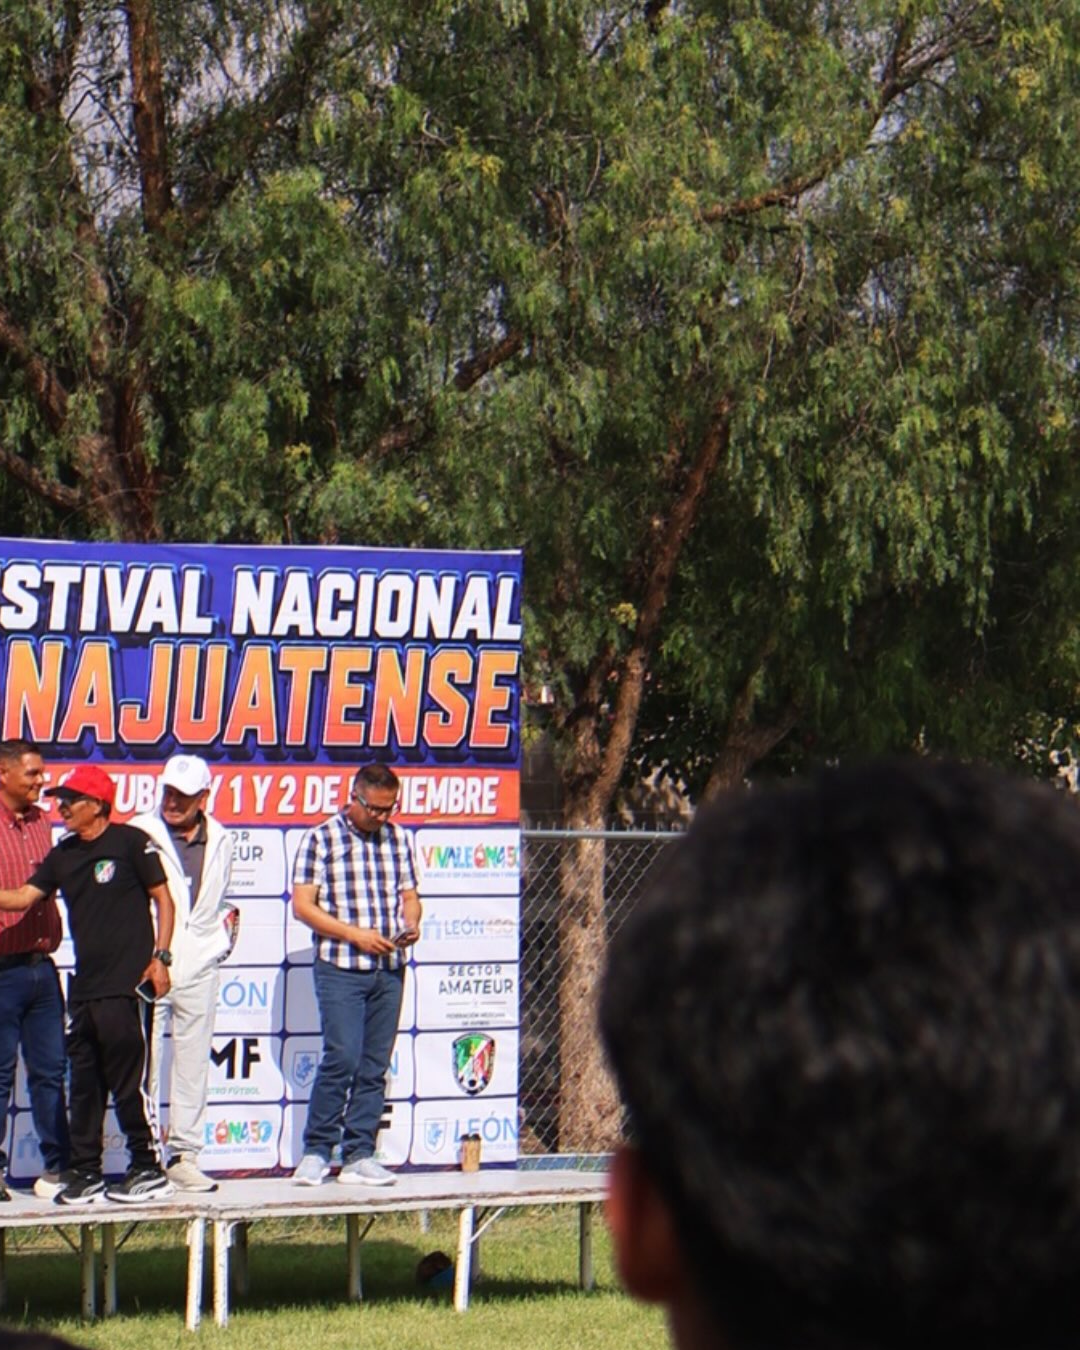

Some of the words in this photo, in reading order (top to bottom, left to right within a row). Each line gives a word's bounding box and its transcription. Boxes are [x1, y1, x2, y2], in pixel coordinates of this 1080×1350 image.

[231, 568, 521, 640] NACIONAL
[228, 774, 243, 813] 1
[253, 774, 274, 814] Y
[278, 775, 296, 814] 2
[303, 775, 342, 815] DE
[350, 776, 500, 816] IEMBRE
[448, 964, 502, 977] SECTOR
[439, 978, 513, 995] AMATEUR
